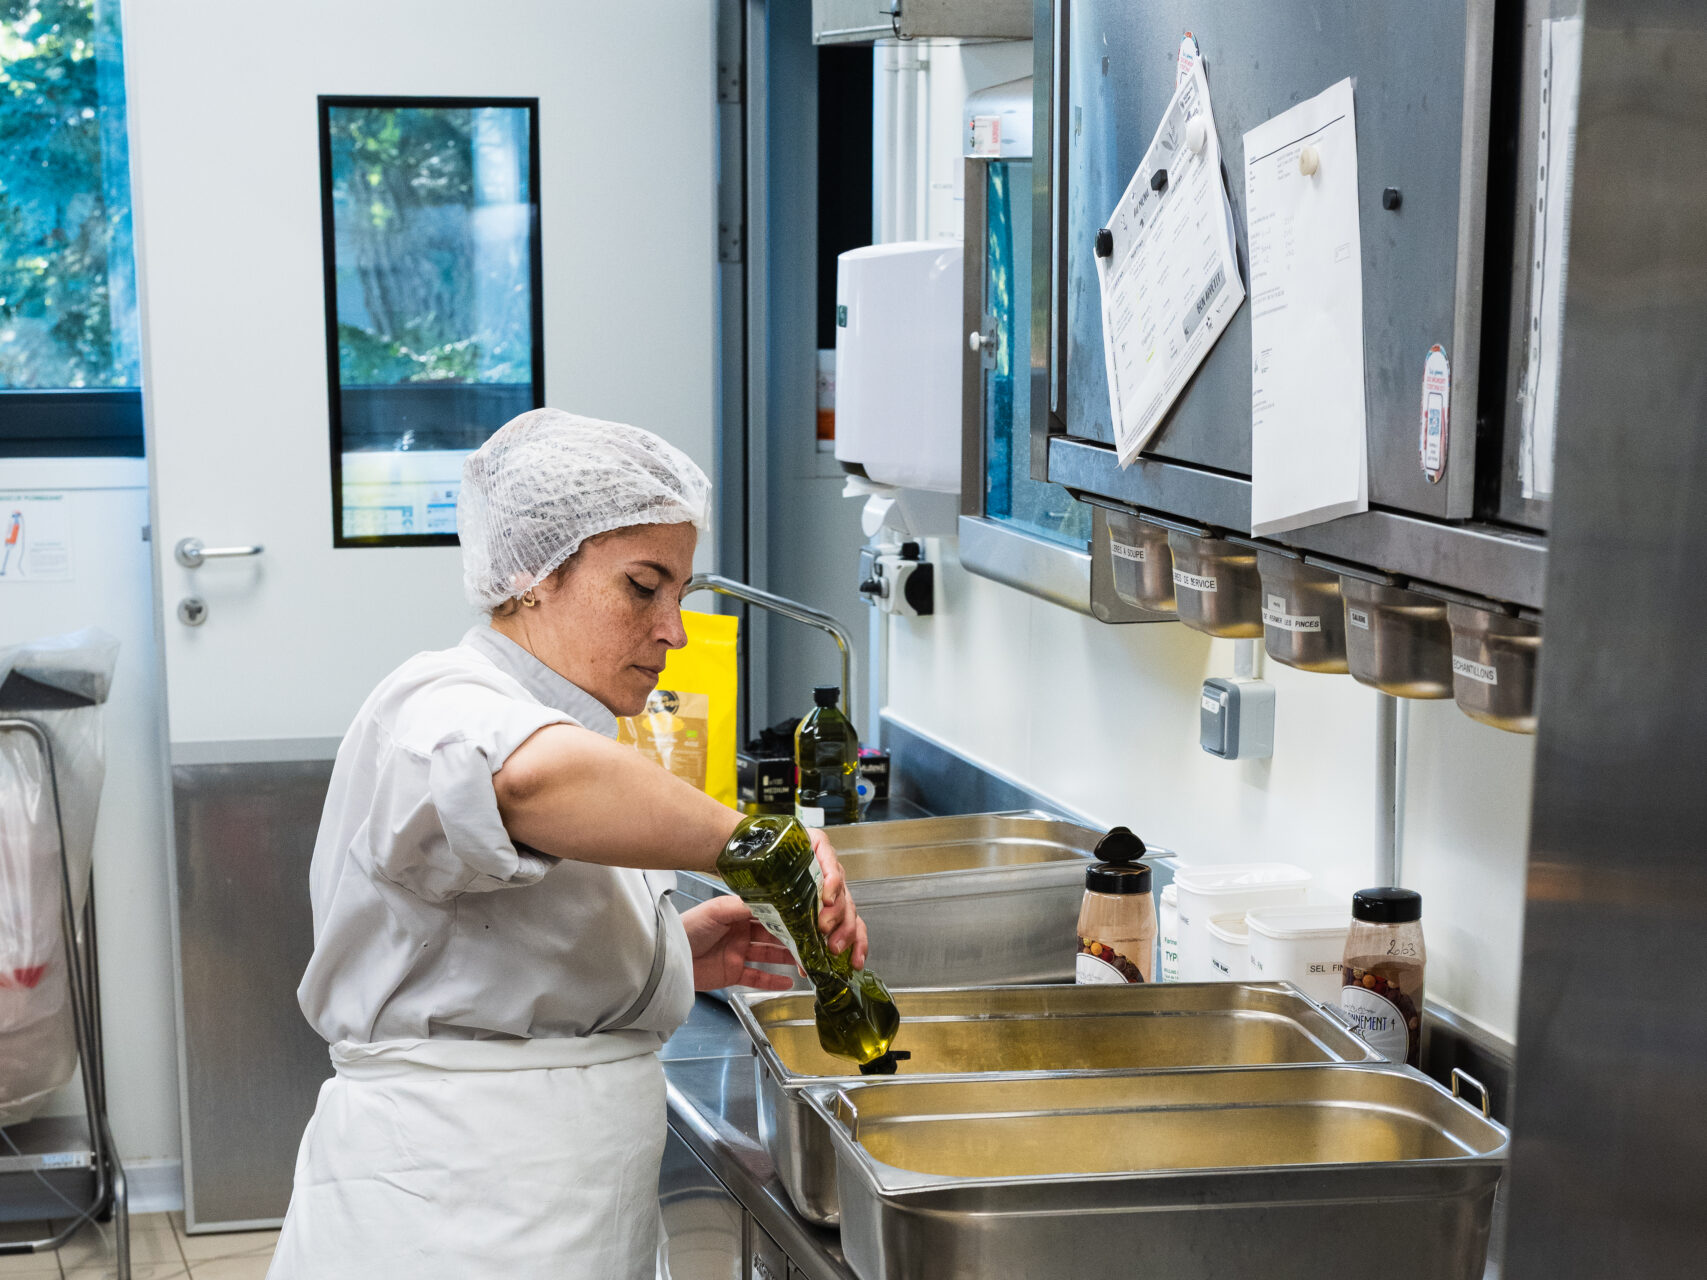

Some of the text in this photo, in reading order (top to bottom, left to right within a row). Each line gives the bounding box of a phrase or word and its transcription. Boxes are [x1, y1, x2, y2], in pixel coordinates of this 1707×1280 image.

[1127, 548, 1145, 559] SOUPE
[1190, 577, 1216, 589] SERVICE
[1294, 620, 1320, 628] PINCES
[1310, 964, 1326, 973] SEL
